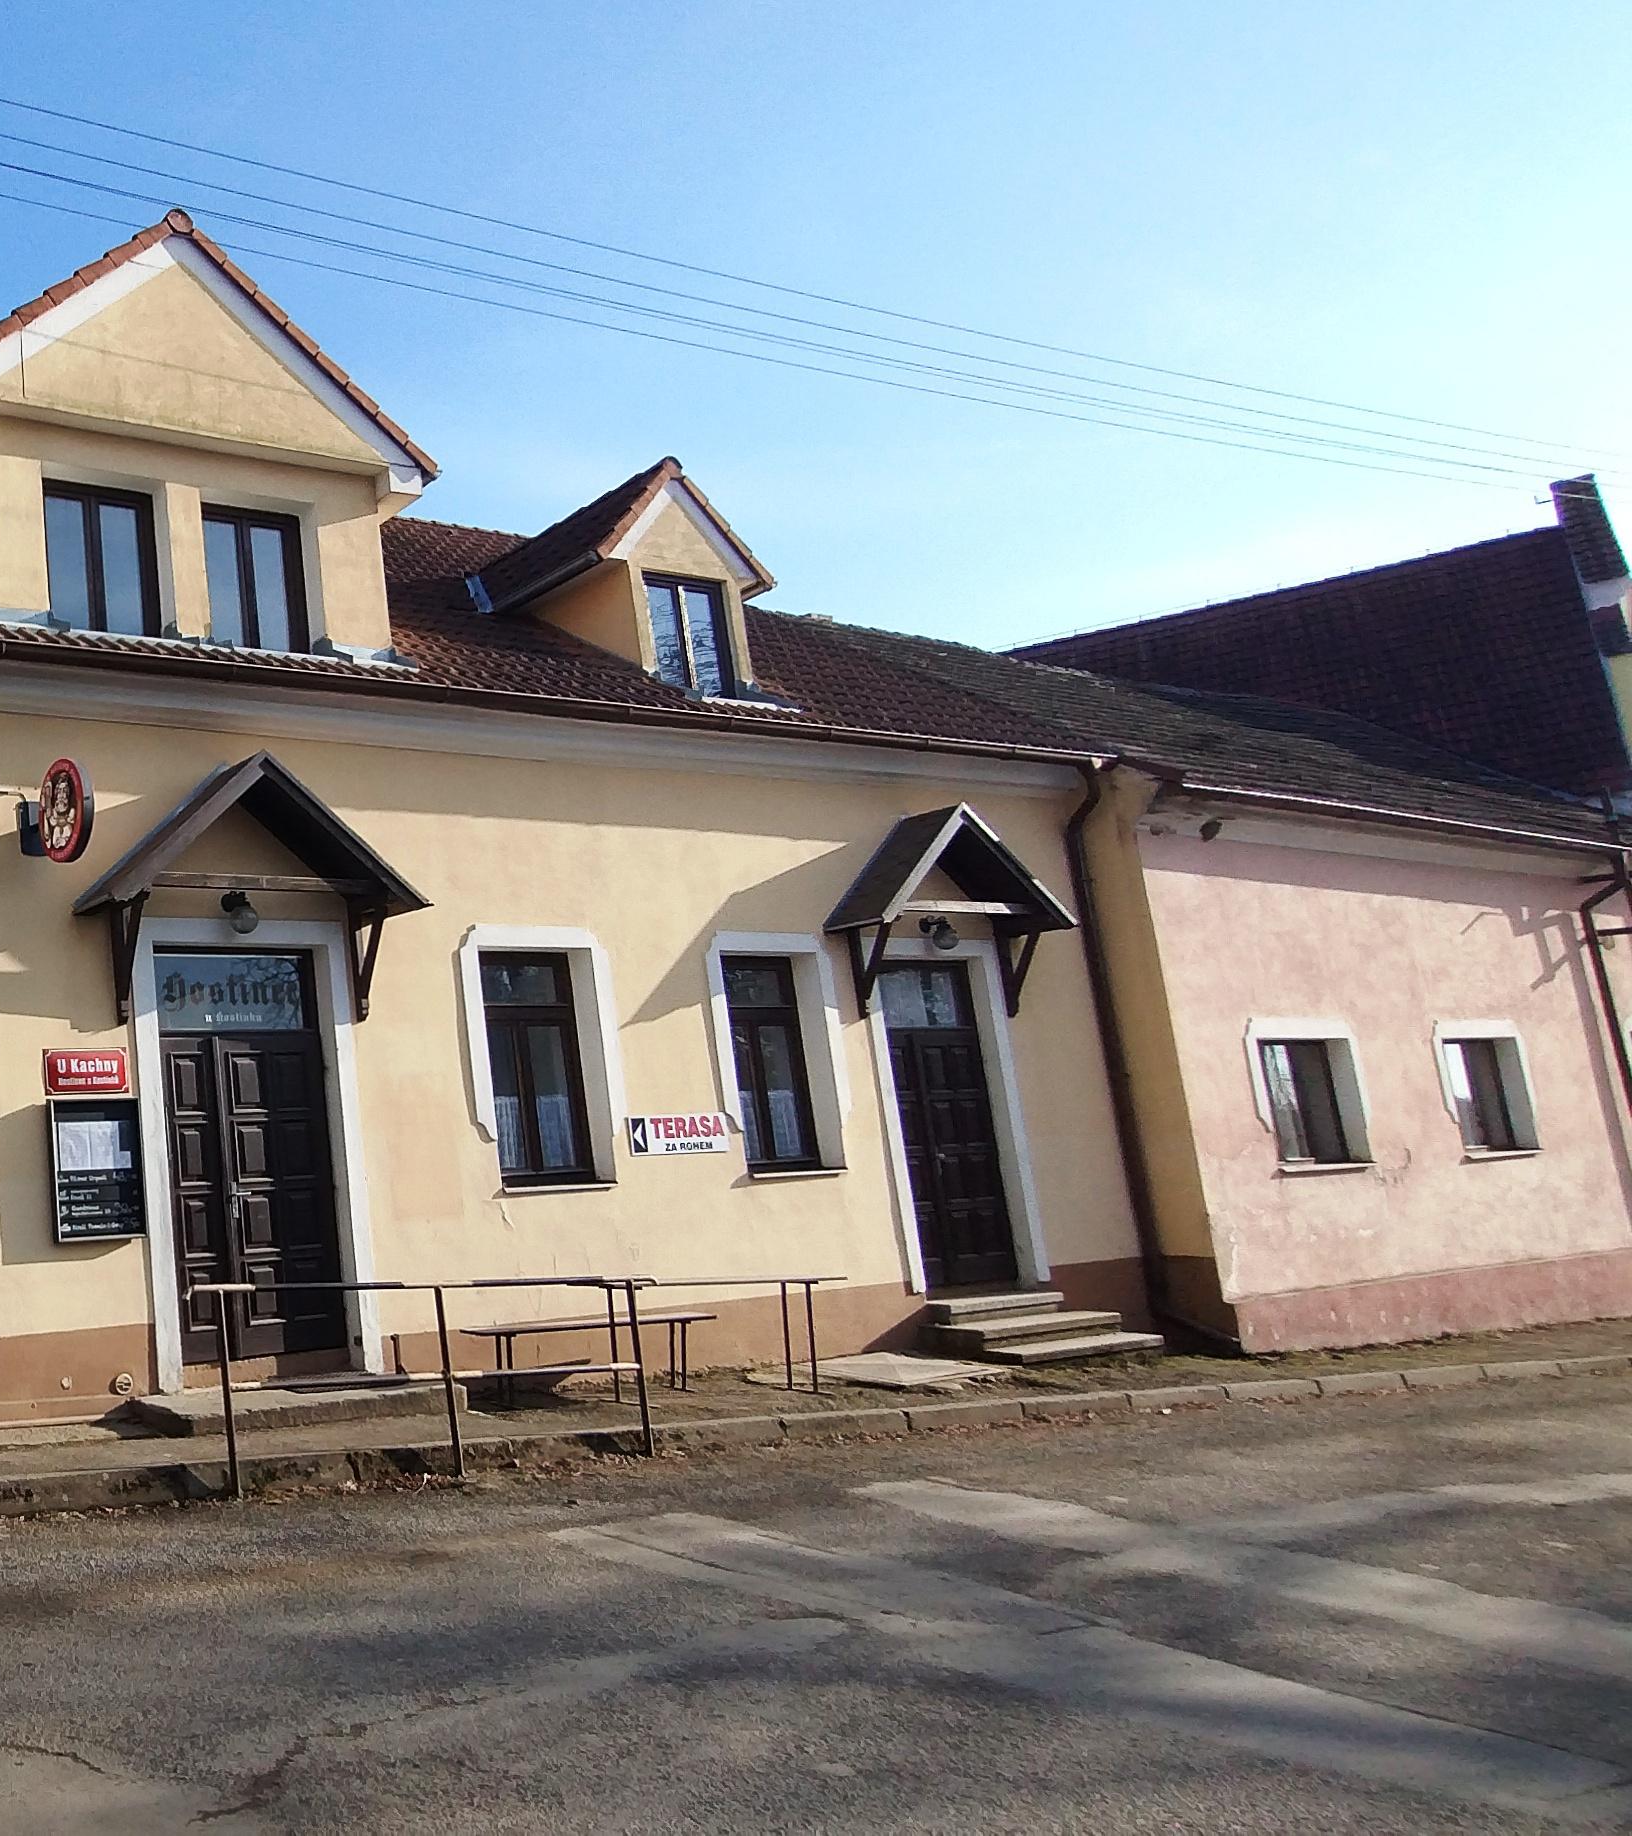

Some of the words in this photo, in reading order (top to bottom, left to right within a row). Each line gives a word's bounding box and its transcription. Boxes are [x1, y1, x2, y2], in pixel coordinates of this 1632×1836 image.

[162, 971, 297, 1012] Hostinec
[57, 1058, 67, 1074] U
[70, 1057, 118, 1074] Kachny
[649, 1115, 726, 1139] TERASA
[665, 1142, 678, 1152] ZA
[680, 1141, 713, 1151] ROHEM
